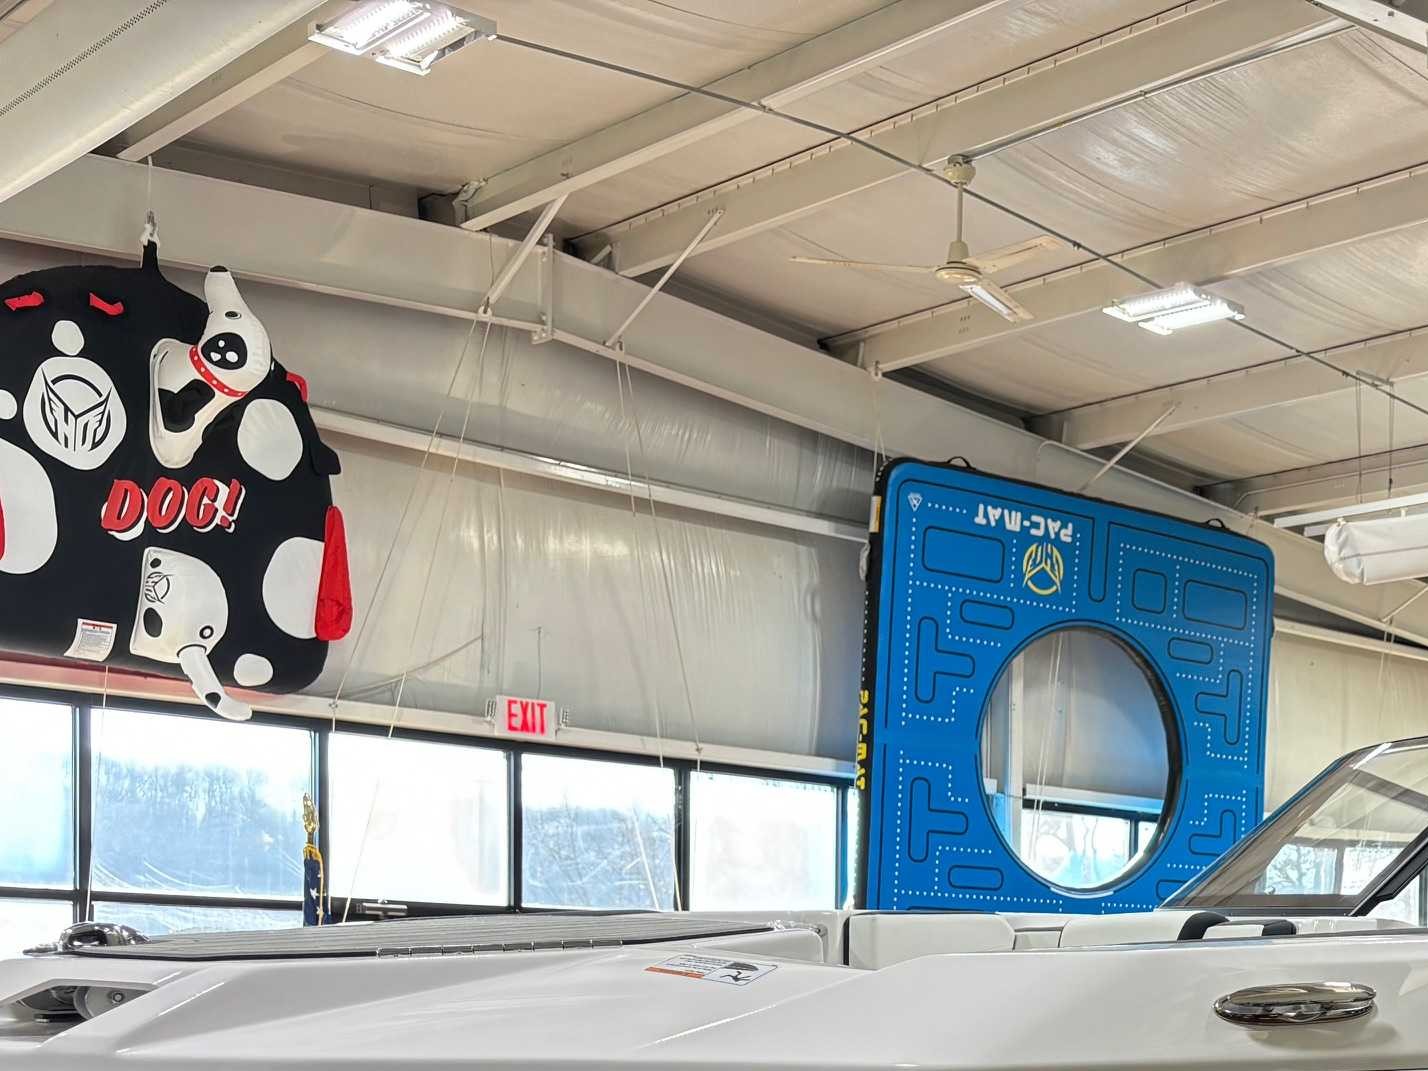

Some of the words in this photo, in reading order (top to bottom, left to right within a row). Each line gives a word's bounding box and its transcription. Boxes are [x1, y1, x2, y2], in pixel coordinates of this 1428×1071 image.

[101, 477, 244, 538] DOG!
[974, 503, 1073, 543] PAC-MAT
[508, 700, 547, 735] EXIT
